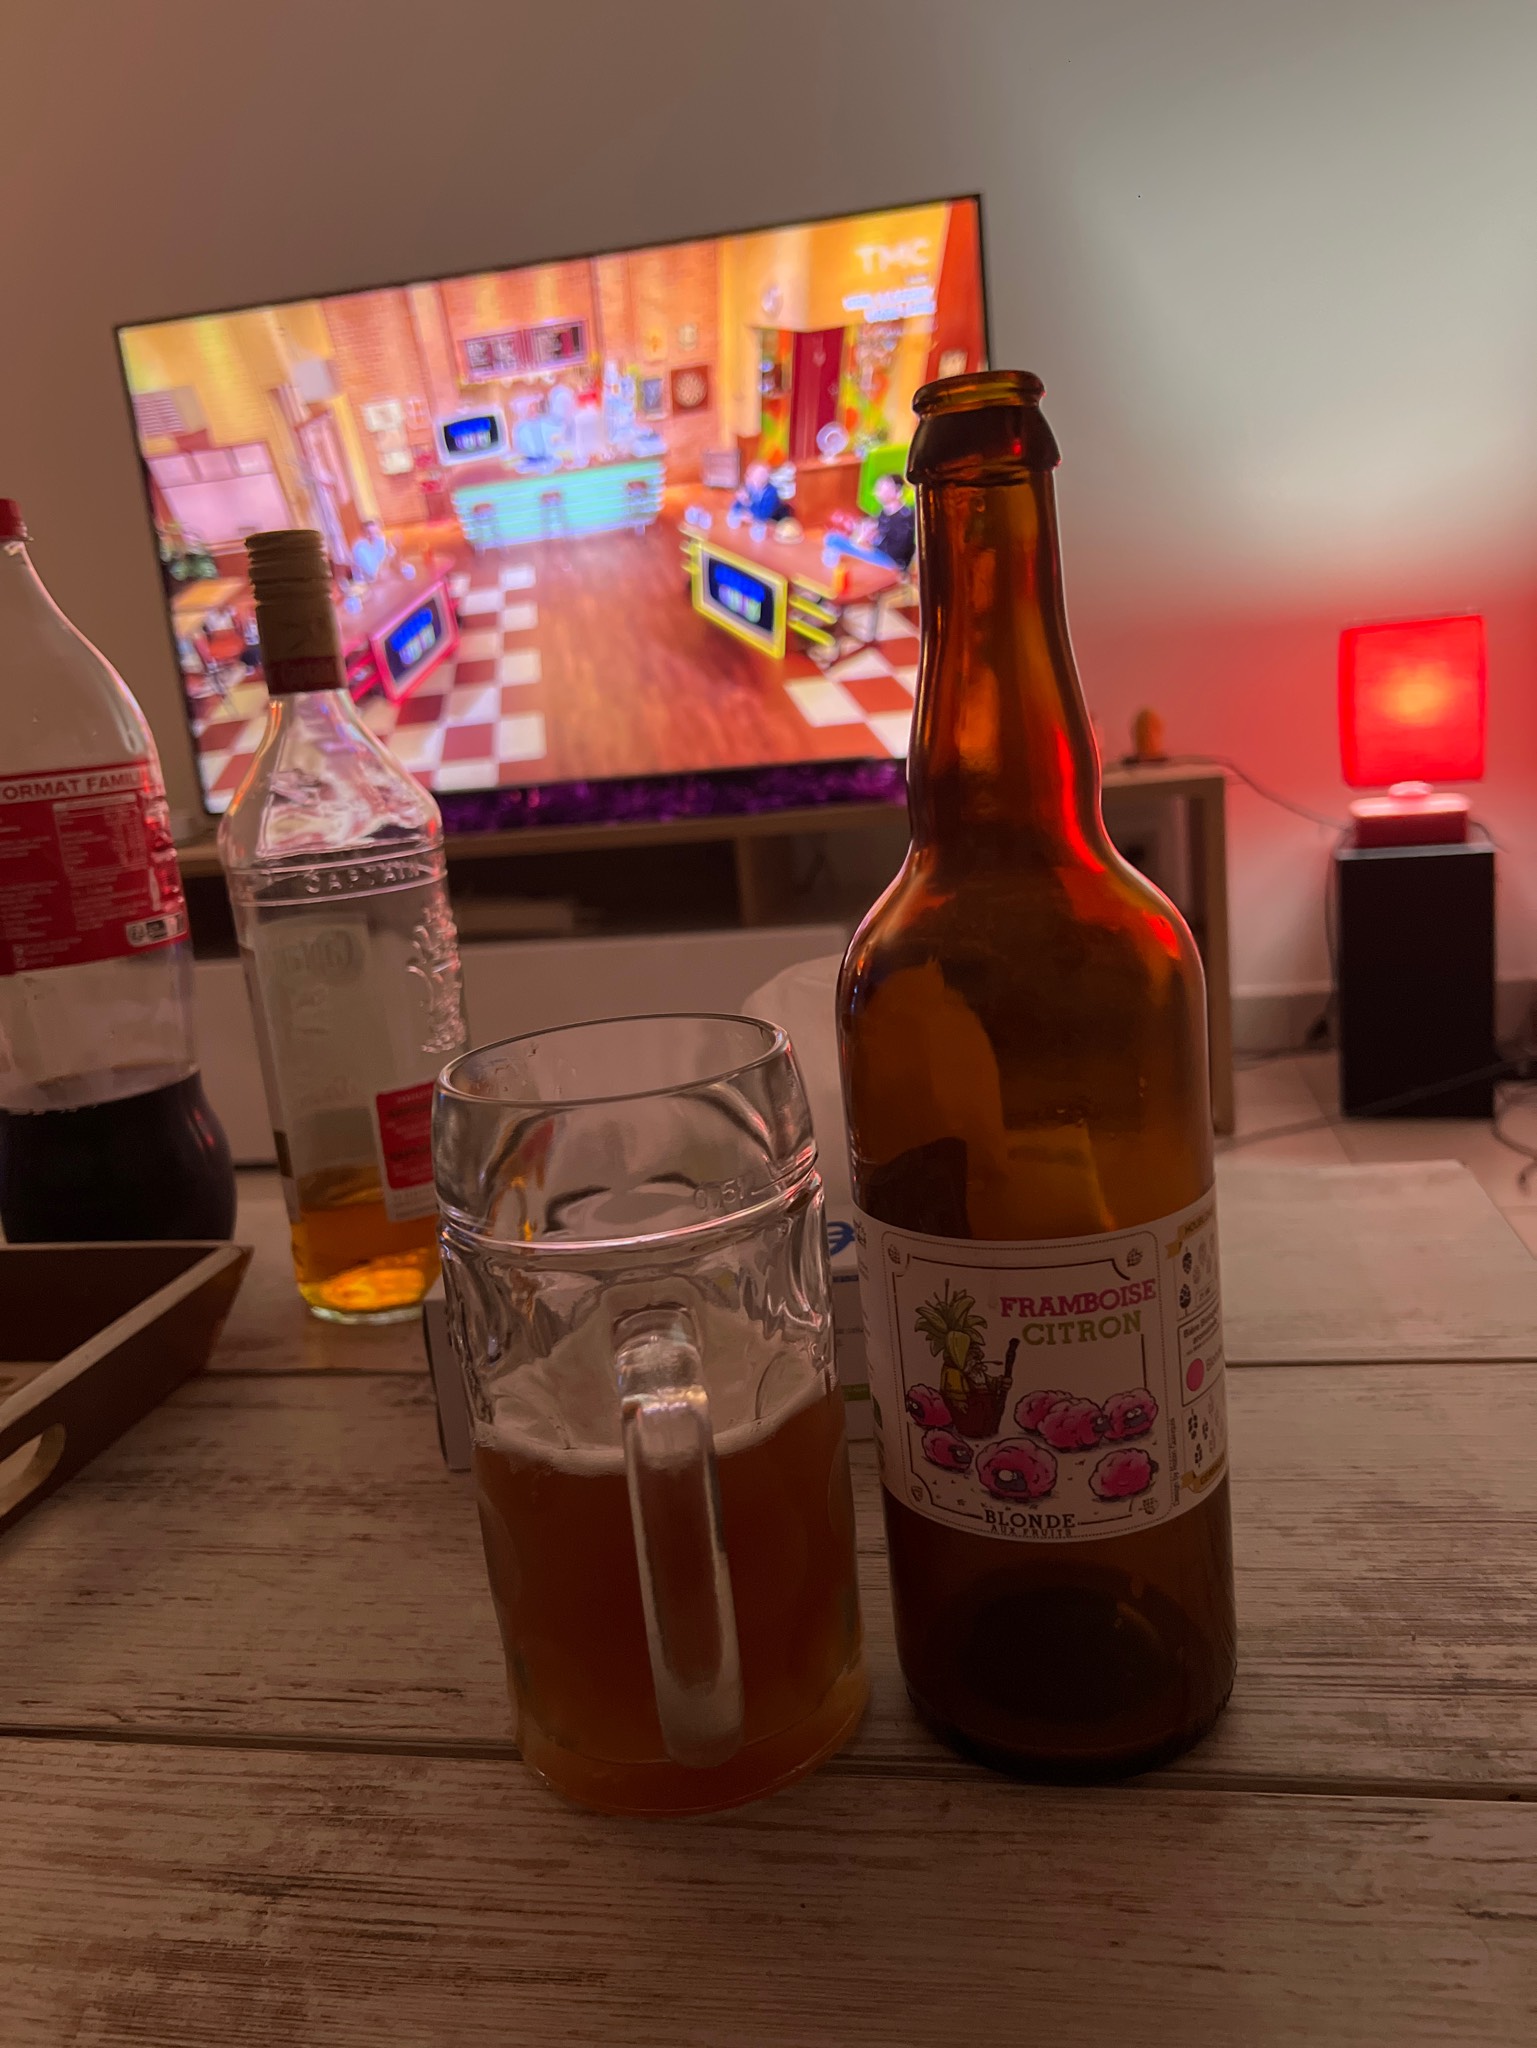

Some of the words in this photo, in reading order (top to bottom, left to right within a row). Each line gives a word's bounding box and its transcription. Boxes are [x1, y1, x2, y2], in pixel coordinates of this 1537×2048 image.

[1000, 1278, 1157, 1318] FRAMBOISE
[1022, 1310, 1142, 1346] CITRON
[985, 1509, 1076, 1530] BLONDE
[991, 1524, 1017, 1538] AUX
